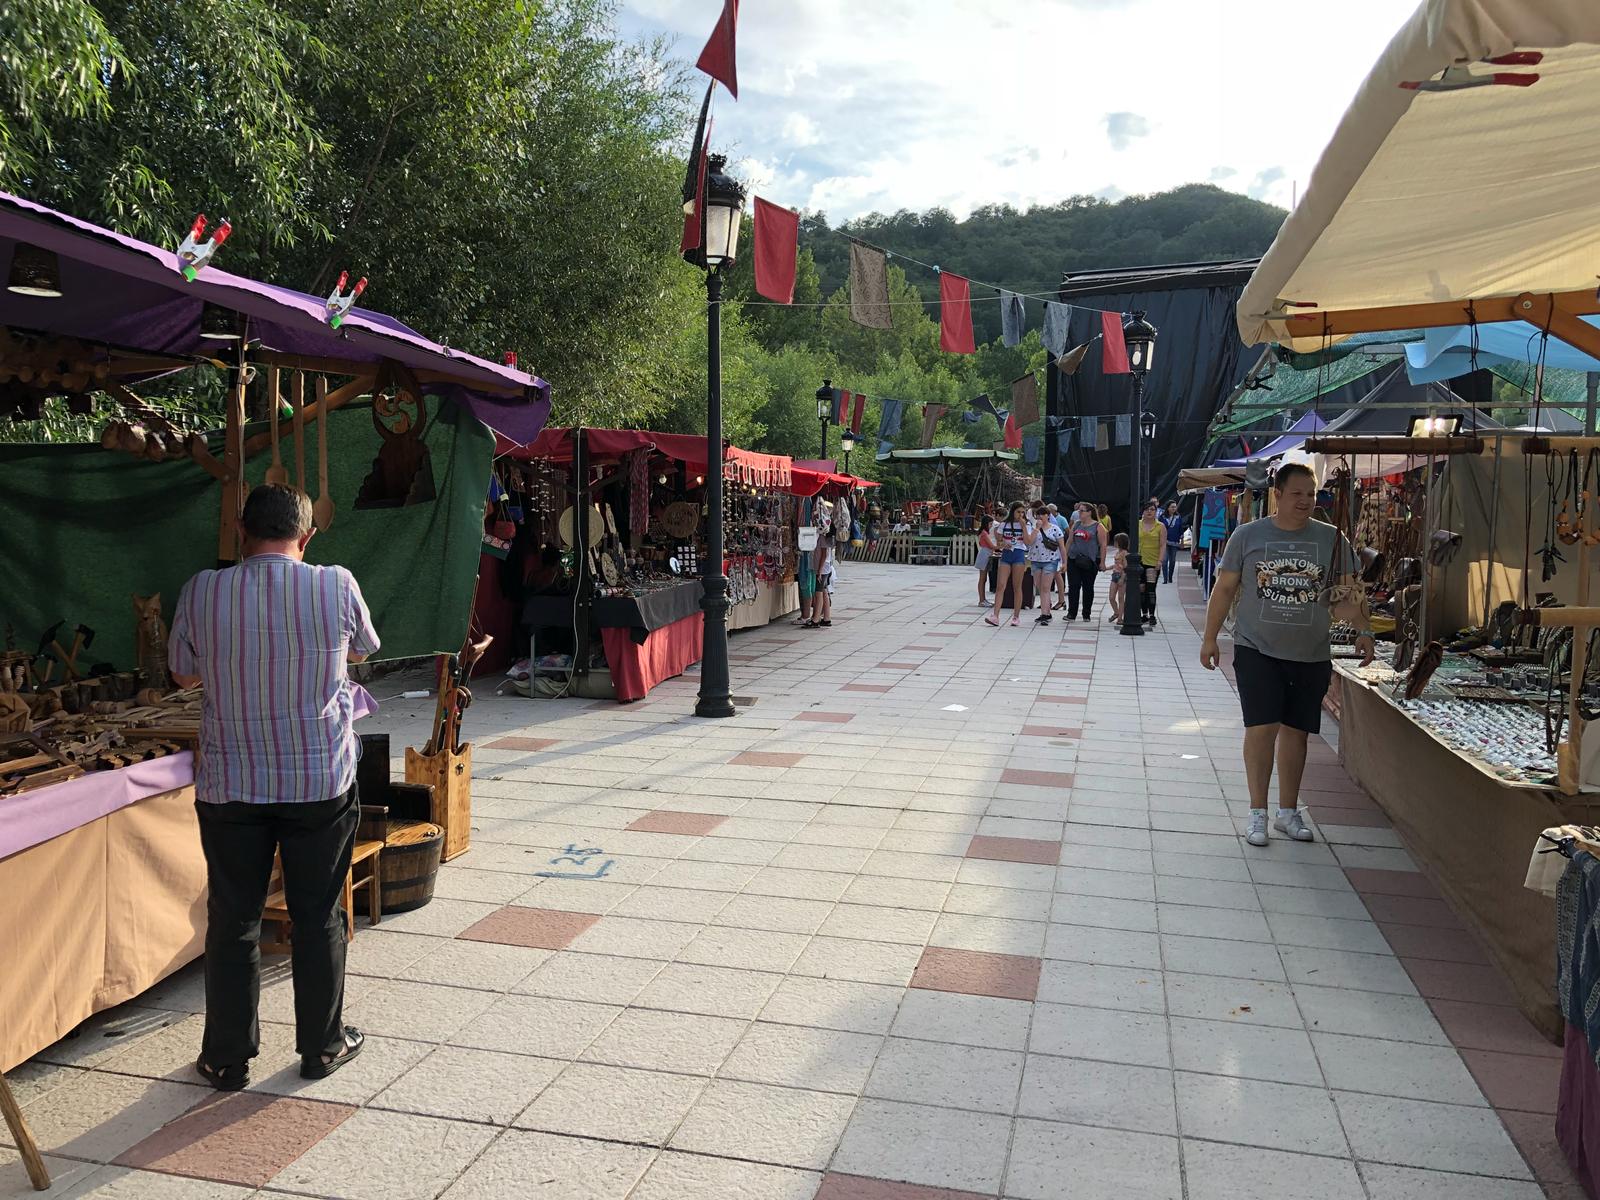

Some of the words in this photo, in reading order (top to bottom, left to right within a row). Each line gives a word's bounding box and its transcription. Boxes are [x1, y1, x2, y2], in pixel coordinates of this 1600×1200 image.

[1260, 558, 1322, 577] DOWNTOWN
[1272, 576, 1309, 587] BRONX
[1262, 588, 1315, 605] SURPLUS
